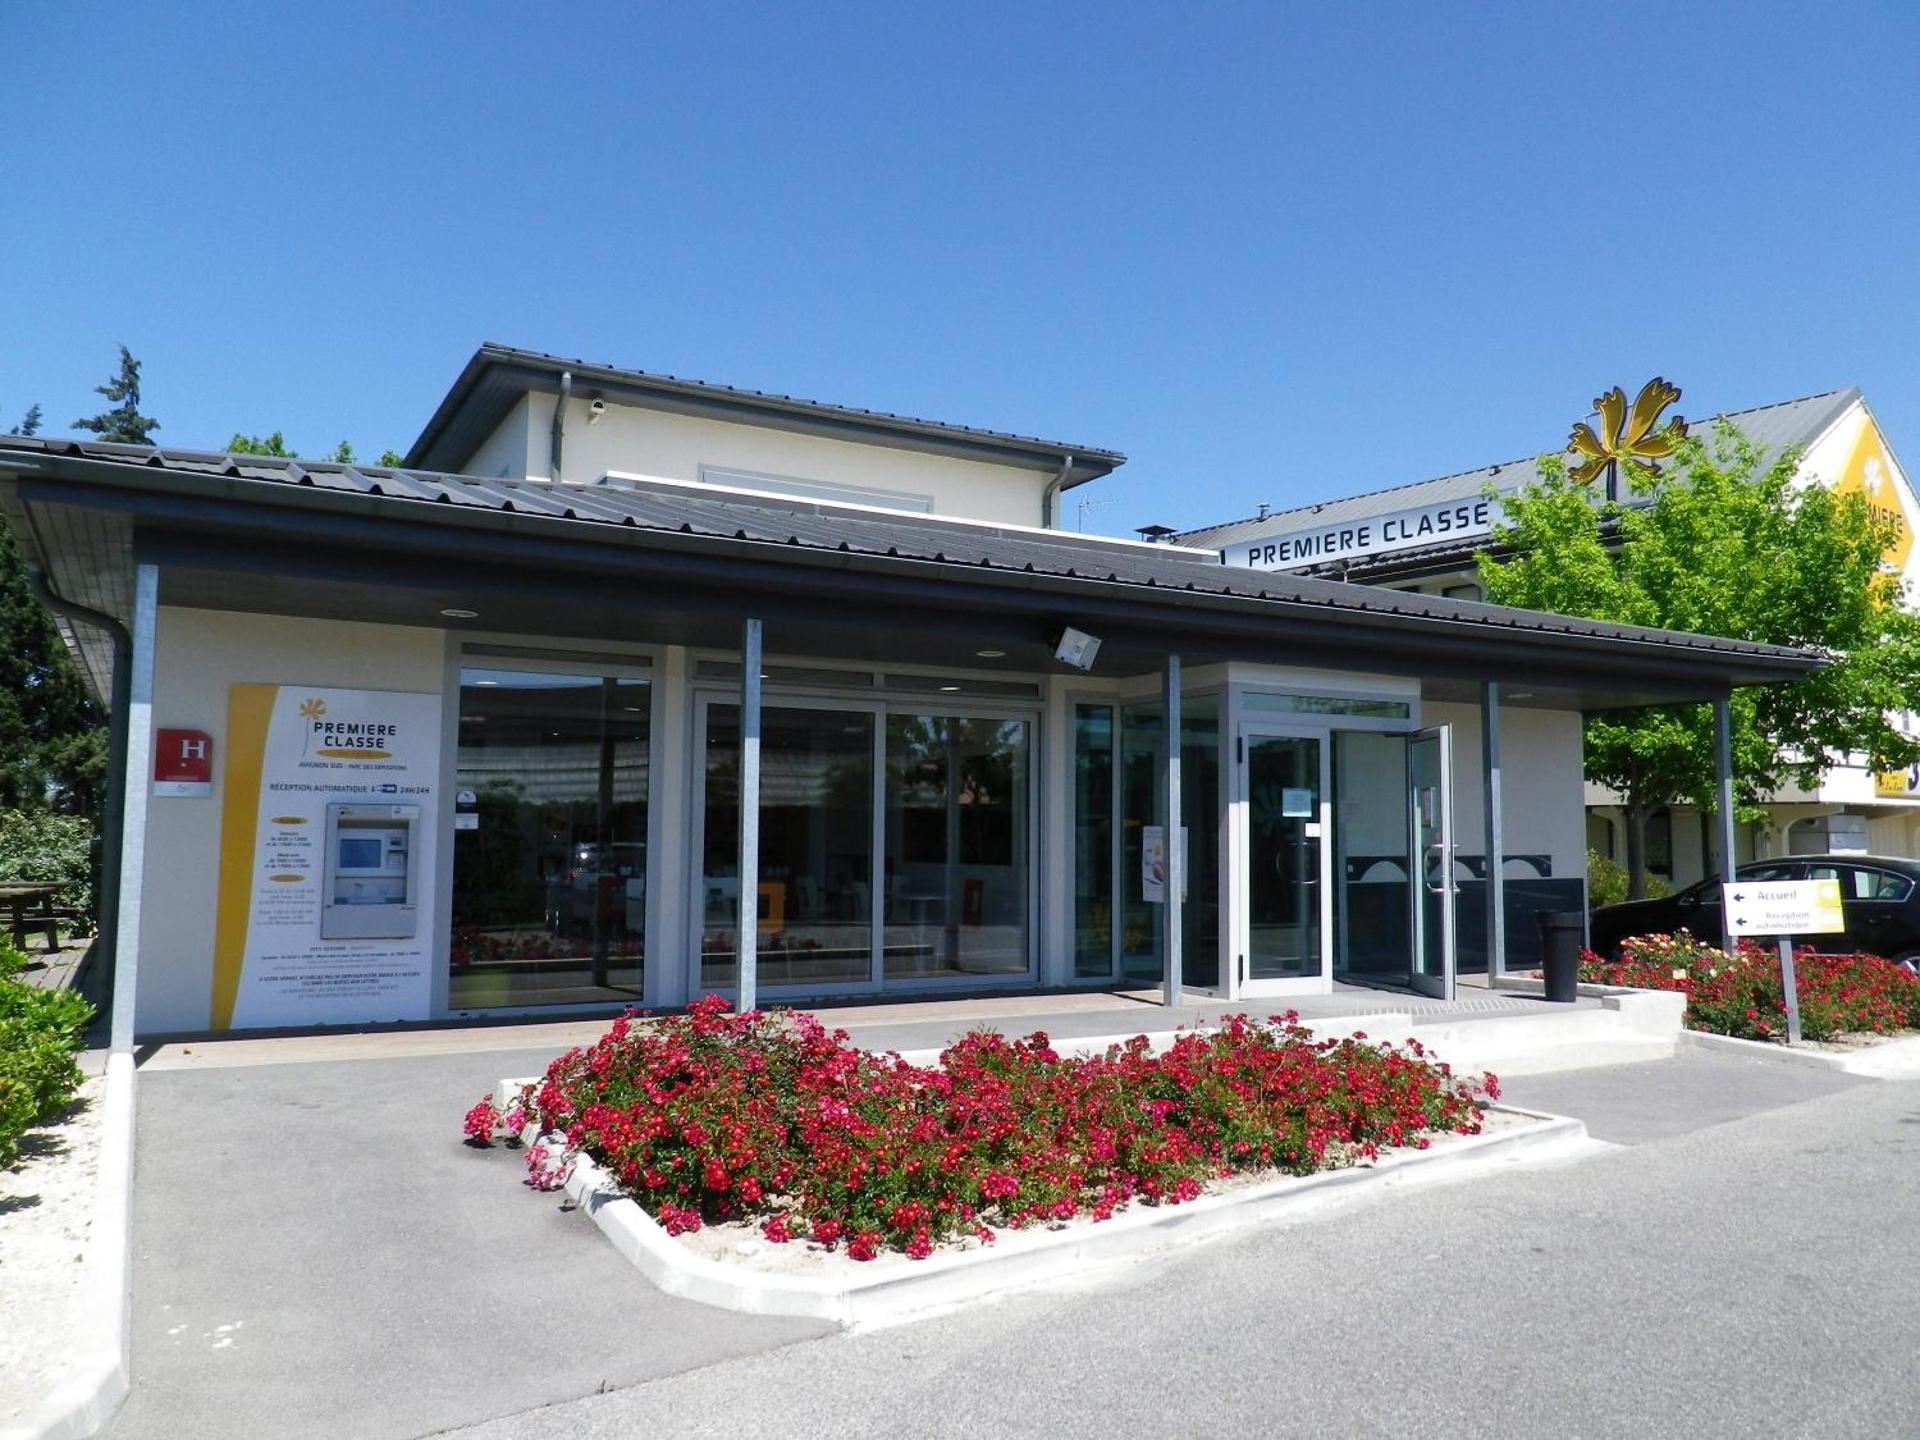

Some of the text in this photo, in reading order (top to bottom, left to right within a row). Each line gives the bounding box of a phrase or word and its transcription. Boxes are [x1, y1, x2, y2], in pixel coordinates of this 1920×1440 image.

[1248, 502, 1488, 567] PREMIERE CLASSE
[314, 721, 397, 736] PREMIERE
[324, 735, 385, 748] CLASSE
[182, 739, 204, 759] H
[314, 784, 368, 794] AUTOMATIQUE
[1757, 890, 1797, 901] Accueil
